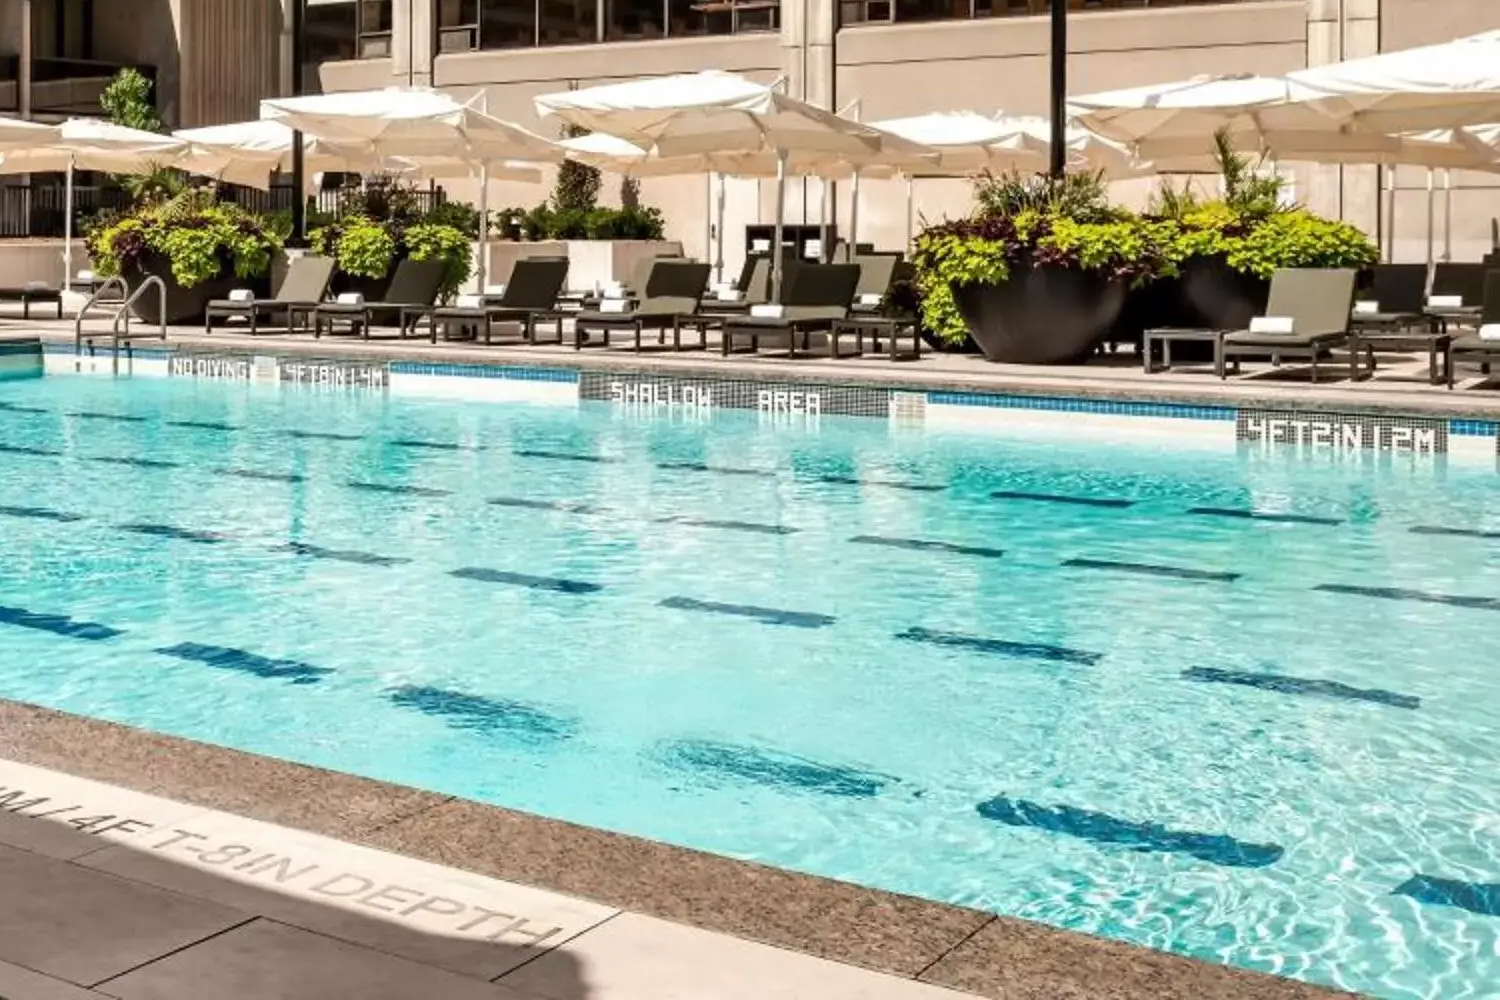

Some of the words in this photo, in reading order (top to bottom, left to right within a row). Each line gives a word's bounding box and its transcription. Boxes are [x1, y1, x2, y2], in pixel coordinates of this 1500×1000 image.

[173, 358, 192, 377] NO
[198, 359, 247, 381] DIVING
[611, 382, 710, 406] SHALLOW
[758, 389, 820, 414] AREA
[308, 872, 562, 949] DEPTH
